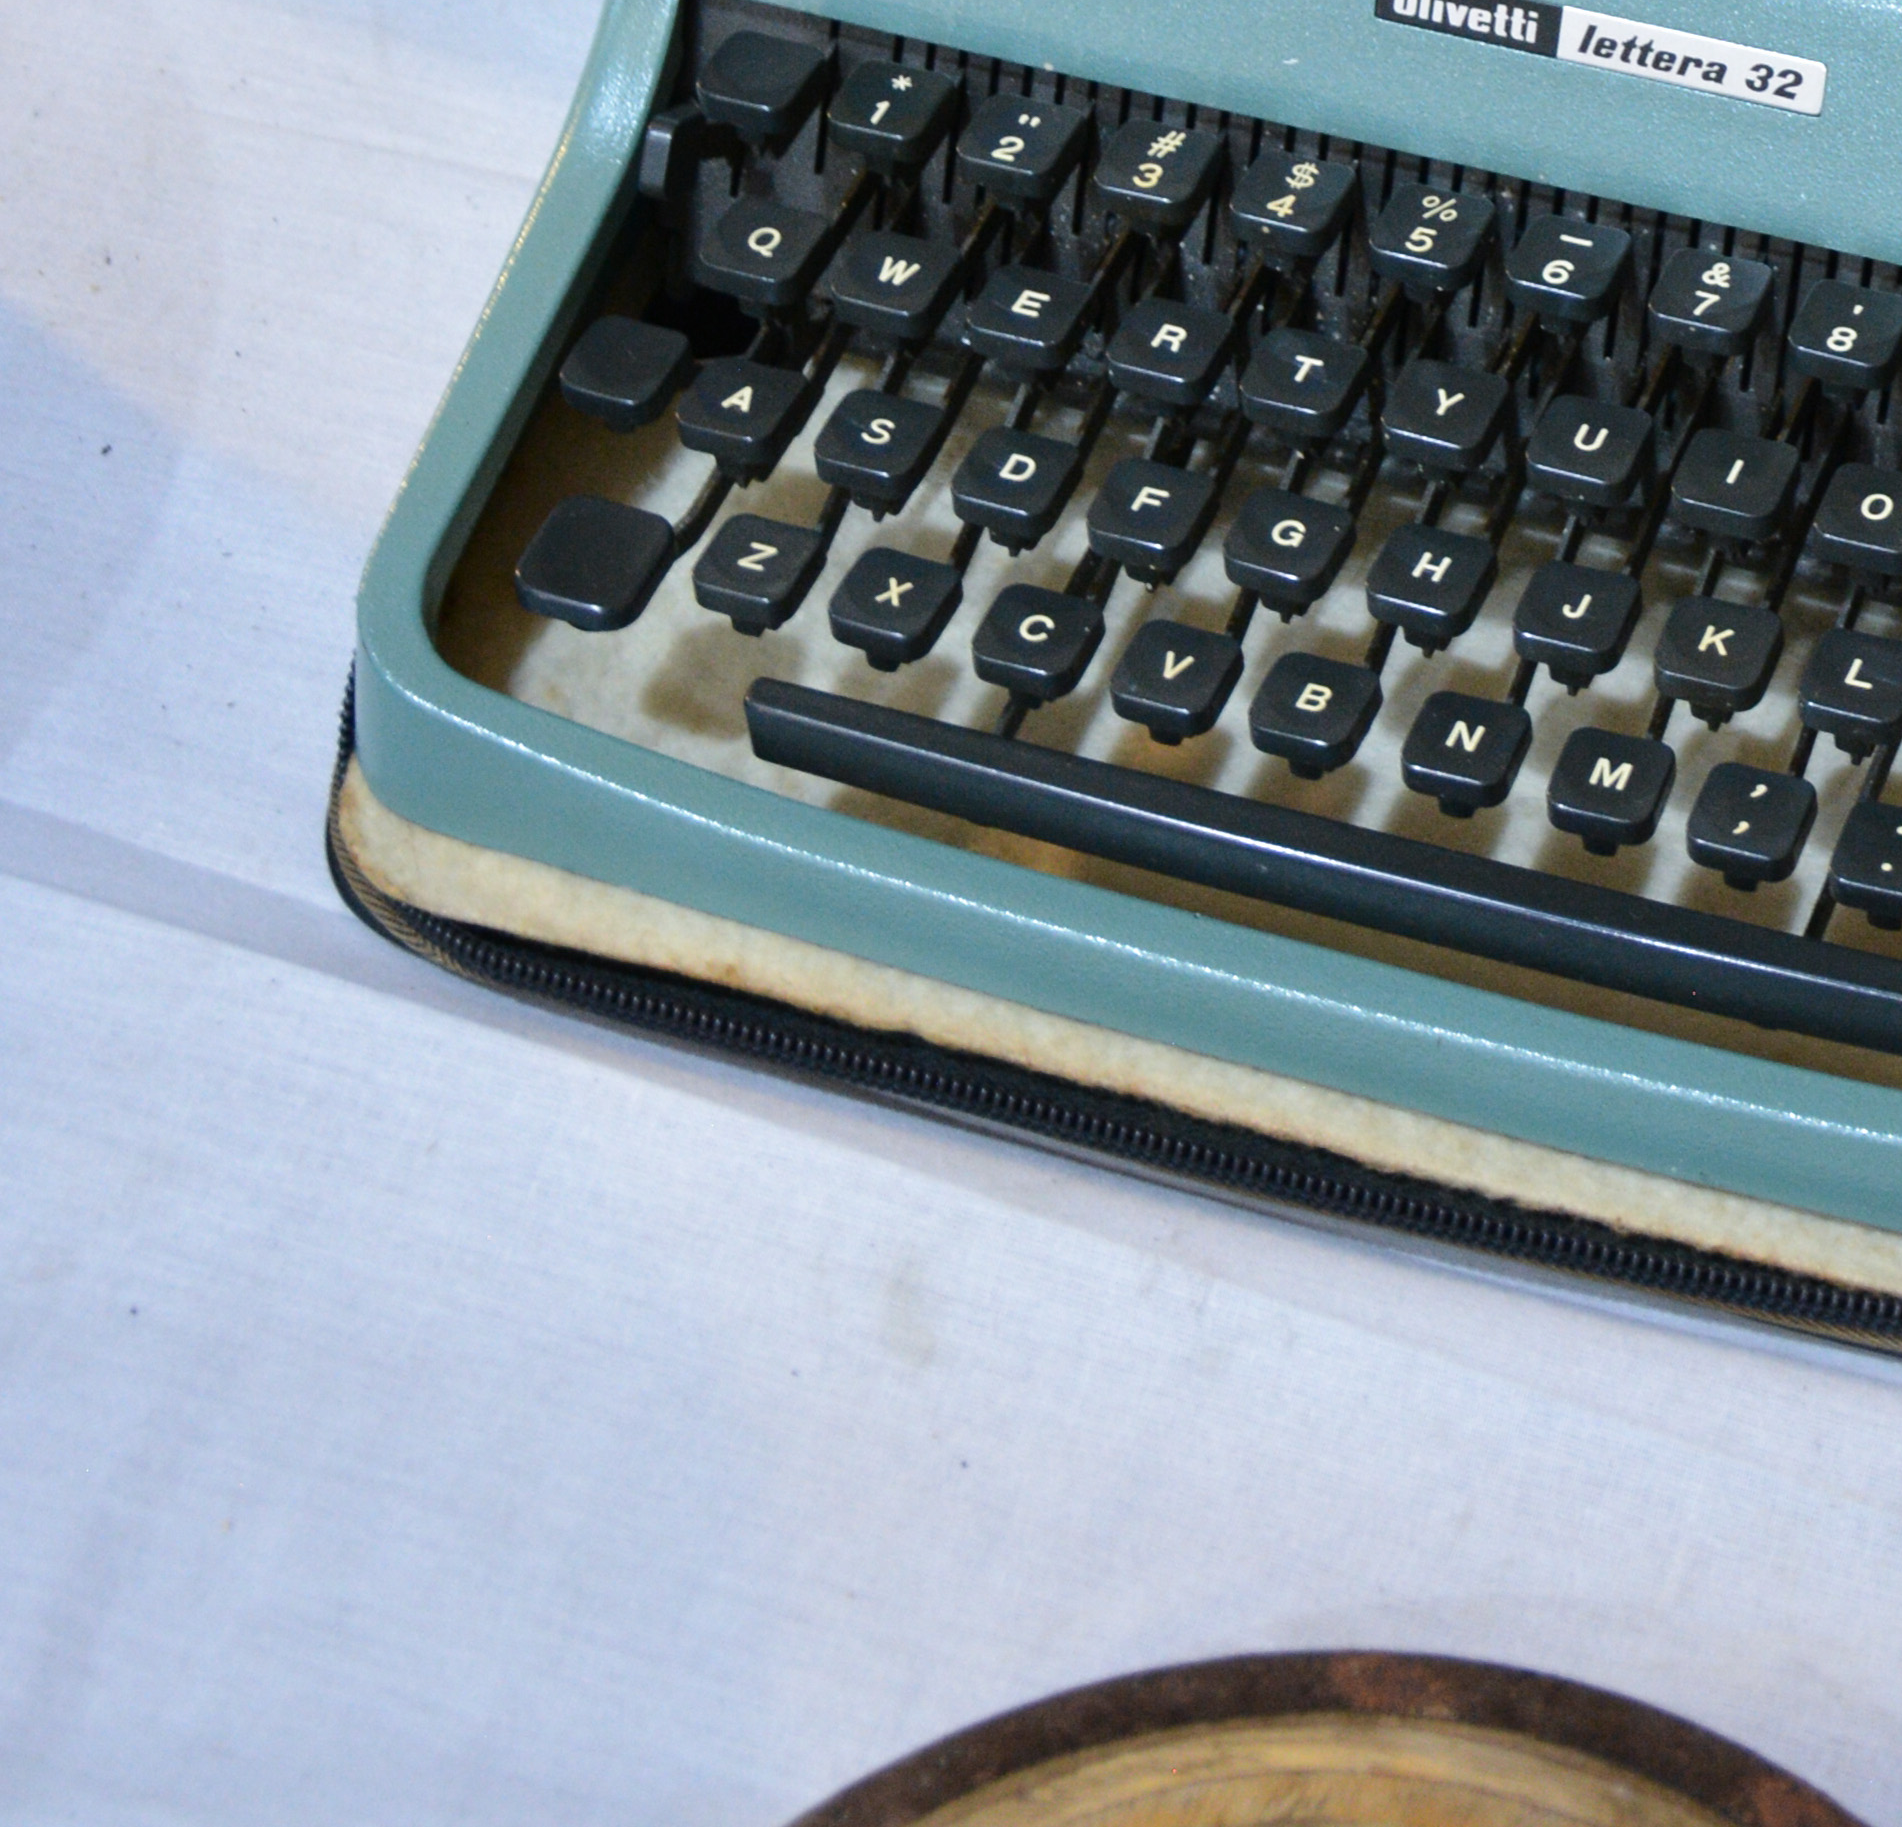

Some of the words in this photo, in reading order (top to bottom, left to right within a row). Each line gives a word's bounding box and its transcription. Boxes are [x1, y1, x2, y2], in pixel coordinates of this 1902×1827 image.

[1578, 24, 1728, 85] lettera
[1744, 62, 1803, 102] 32
[870, 100, 890, 125] 1
[990, 135, 1025, 162] 2
[1132, 162, 1164, 189] 3
[1285, 162, 1320, 190] $
[1266, 194, 1296, 218] 4
[1421, 195, 1458, 222] %
[747, 226, 782, 258] Q
[1404, 226, 1437, 253] 5
[878, 255, 921, 286] W
[1537, 259, 1575, 288] 6
[1701, 262, 1731, 289] &
[1010, 289, 1051, 318] E
[1692, 290, 1721, 316] 7
[1150, 323, 1188, 353] R
[1826, 326, 1858, 353] 8
[1294, 354, 1324, 383] T
[720, 385, 753, 413] A
[1435, 388, 1465, 416] Y
[860, 418, 896, 445] S
[1573, 423, 1609, 452] U
[998, 453, 1037, 482] D
[1725, 459, 1745, 485] I
[1130, 486, 1170, 512] F
[1860, 493, 1894, 521] O
[1271, 519, 1307, 548] G
[736, 541, 778, 572] Z
[1411, 551, 1452, 583] H
[874, 576, 914, 607] X
[1562, 594, 1592, 619] J
[1018, 614, 1055, 643] C
[1697, 625, 1735, 656] K
[1162, 650, 1195, 680] V
[1844, 658, 1873, 690] L
[1295, 682, 1333, 712] B
[1445, 720, 1486, 753] N
[1588, 757, 1634, 791] M
